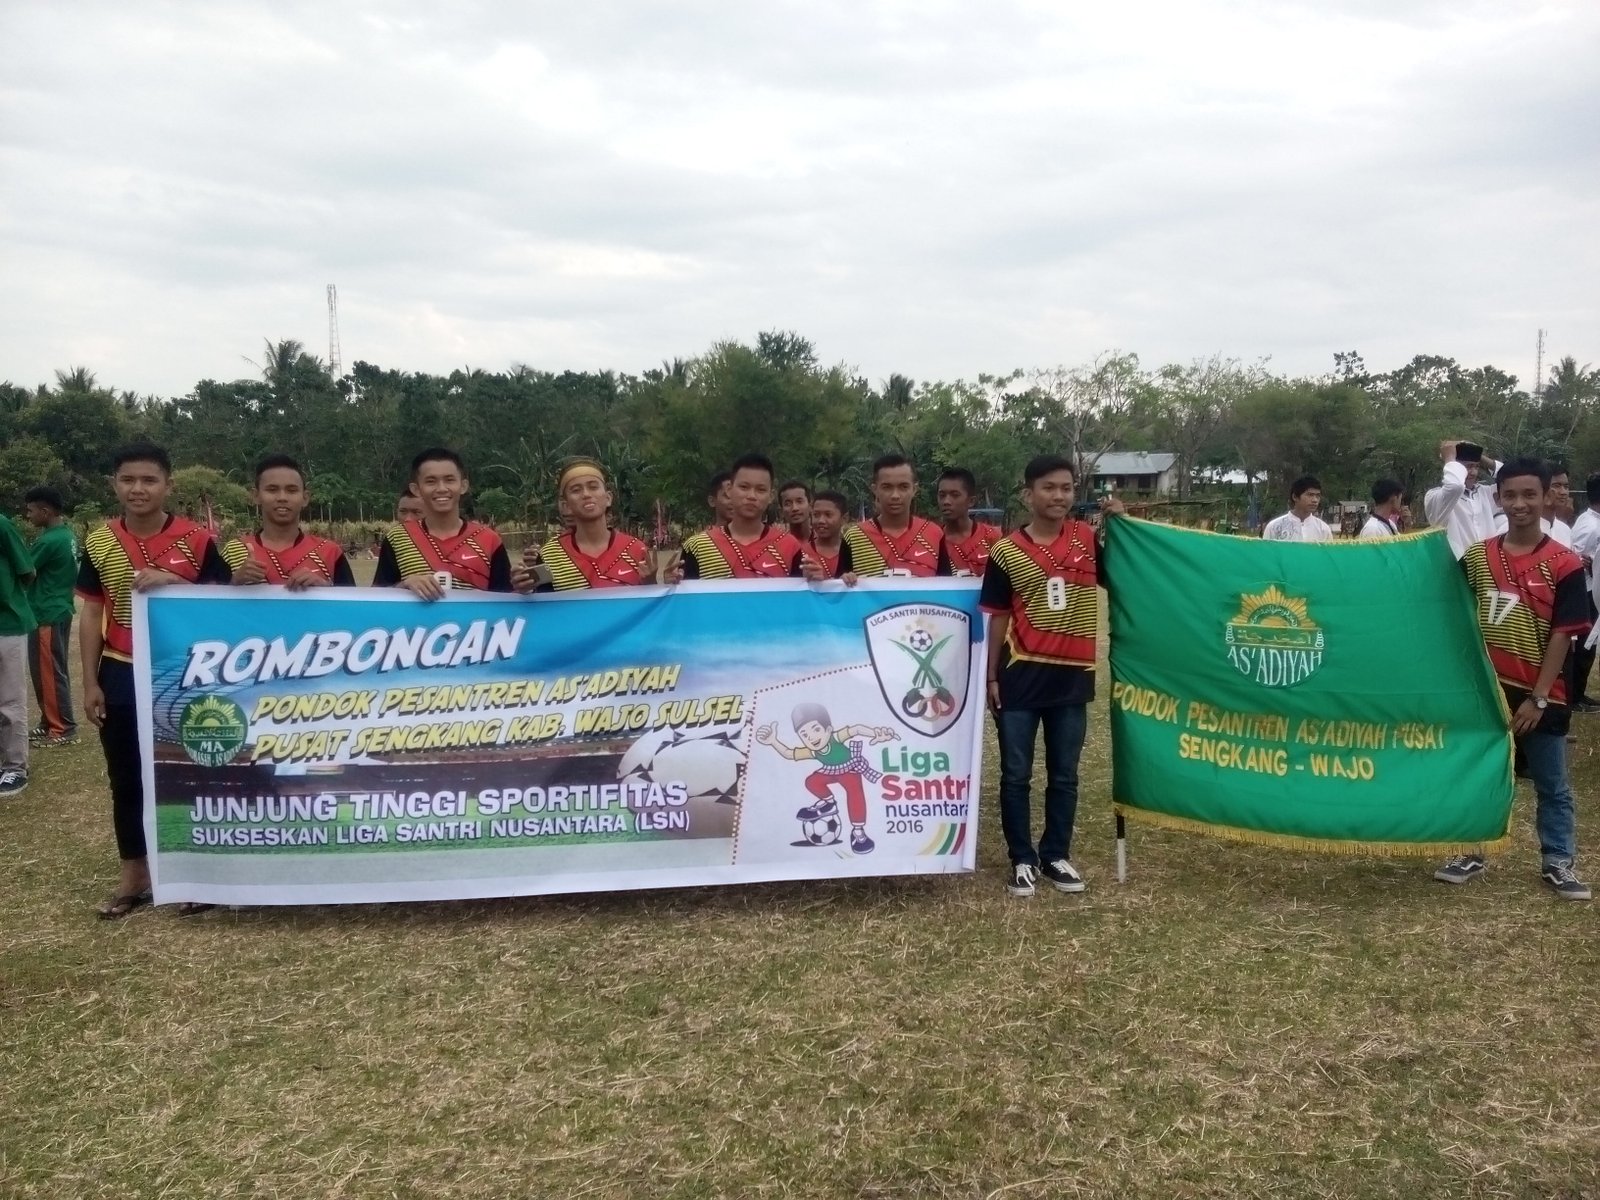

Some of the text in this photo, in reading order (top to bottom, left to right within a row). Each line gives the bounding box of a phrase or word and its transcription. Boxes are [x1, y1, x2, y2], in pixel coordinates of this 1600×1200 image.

[1047, 576, 1067, 611] 8
[1486, 590, 1520, 625] 17
[870, 608, 968, 627] LIGA SANTRI NUSANTARA
[181, 617, 526, 690] ROMBONGAN
[1227, 645, 1322, 686] AS'ADIYAH
[250, 664, 682, 725] PONDOK PESANTREN AS'ADIYAH
[251, 729, 351, 765] PUSAT
[350, 718, 503, 759] SENGKANG
[574, 704, 651, 738] WAJO
[653, 695, 744, 732] SULSEL
[1113, 682, 1448, 750] PONDOK PESANTREN AS'ADIYAH PUSAT
[200, 741, 225, 752] MA
[881, 746, 950, 777] Liga
[1179, 732, 1288, 777] SENGKANG
[1310, 753, 1375, 780] WAJO
[190, 780, 689, 823] JUNJUNG TINGGI SPORTIFITAS
[191, 810, 690, 846] SUKSESKAN LIGA SANTRI NUSANTARA (LSN)
[886, 820, 924, 834] 2016
